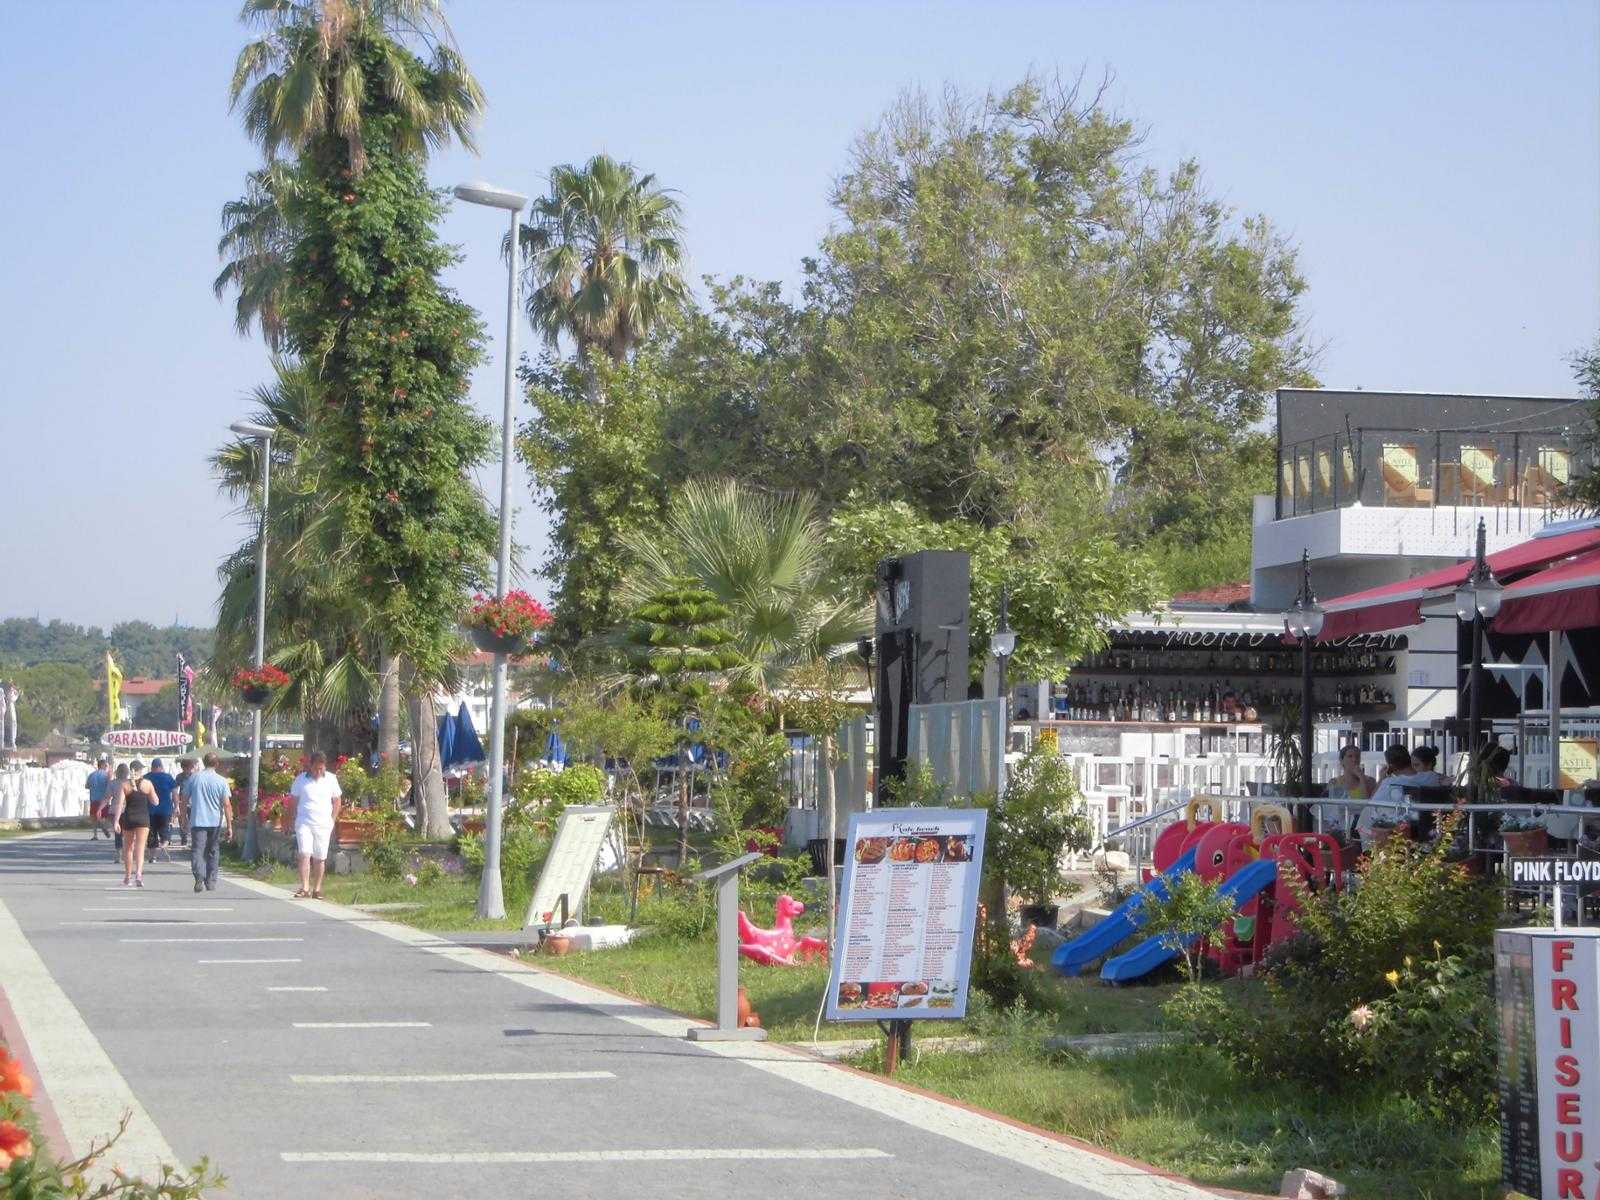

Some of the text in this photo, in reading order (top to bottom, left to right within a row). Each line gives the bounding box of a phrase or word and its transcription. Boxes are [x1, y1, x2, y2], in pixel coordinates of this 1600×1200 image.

[107, 732, 188, 748] PARASAILING
[1514, 861, 1600, 882] PINK FLOYD
[1551, 941, 1584, 1199] FRISEUR
